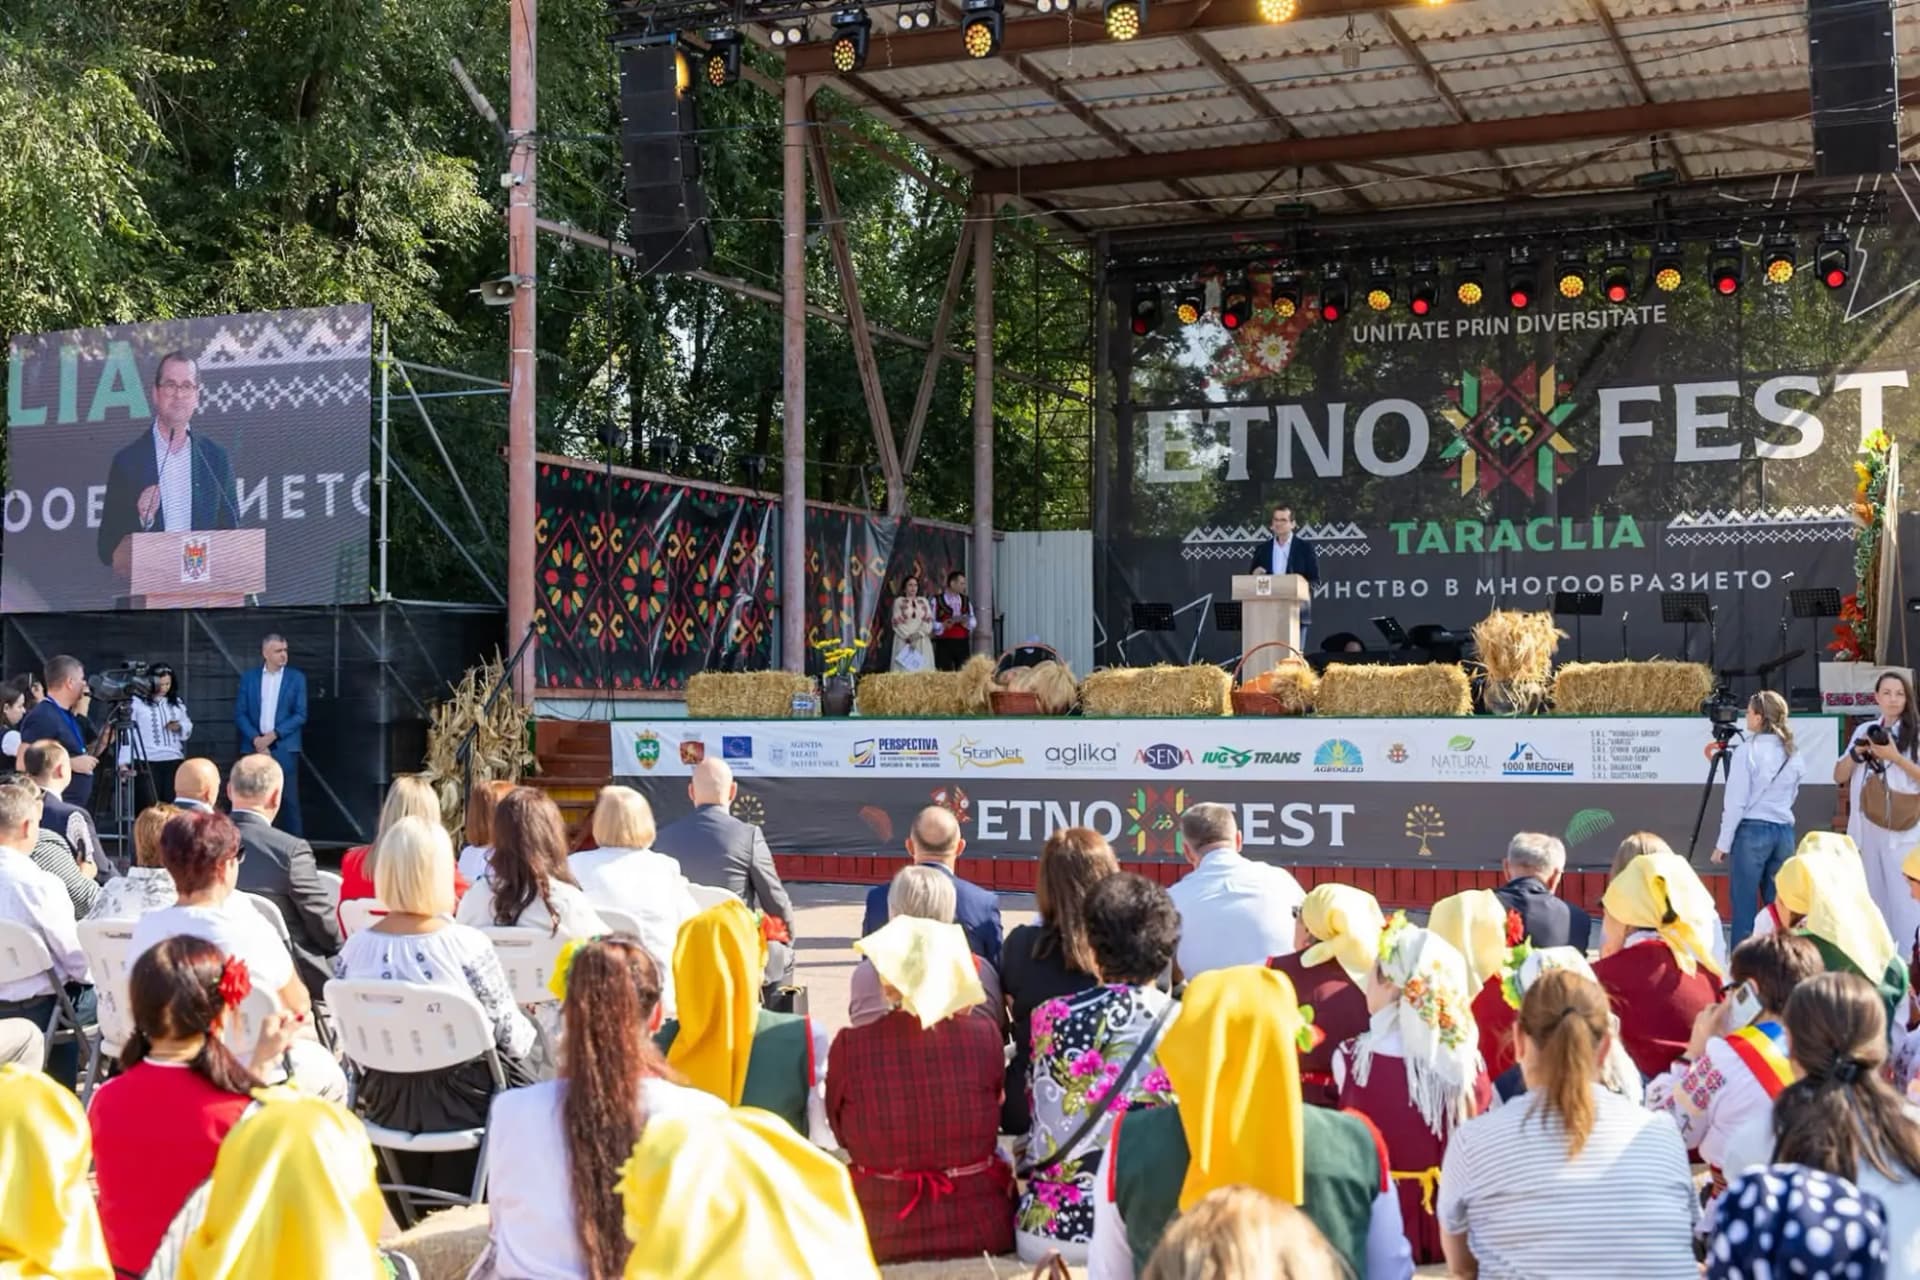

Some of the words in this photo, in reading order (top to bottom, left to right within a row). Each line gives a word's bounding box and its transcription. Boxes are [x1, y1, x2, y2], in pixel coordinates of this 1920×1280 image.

[1353, 319, 1449, 343] UNITATE
[1456, 315, 1509, 337] PRIN
[1517, 304, 1667, 334] DIVERSITATE
[1145, 398, 1430, 484] ETNO
[1596, 369, 1909, 466] FEST
[1388, 515, 1646, 555] TARACLIA
[1445, 578, 1459, 596] В
[1475, 569, 1773, 596] МНОГООБРАЗИЕТО
[878, 737, 938, 750] PERSPECTIVA
[962, 745, 1023, 760] StarNet
[1045, 743, 1117, 766] aglika
[1134, 748, 1194, 765] ASENA
[1253, 751, 1302, 764] TRANS
[1431, 754, 1492, 769] NATURAL
[1502, 762, 1525, 771] 1000
[977, 799, 1122, 843] ETNO
[1216, 802, 1356, 847] EST
